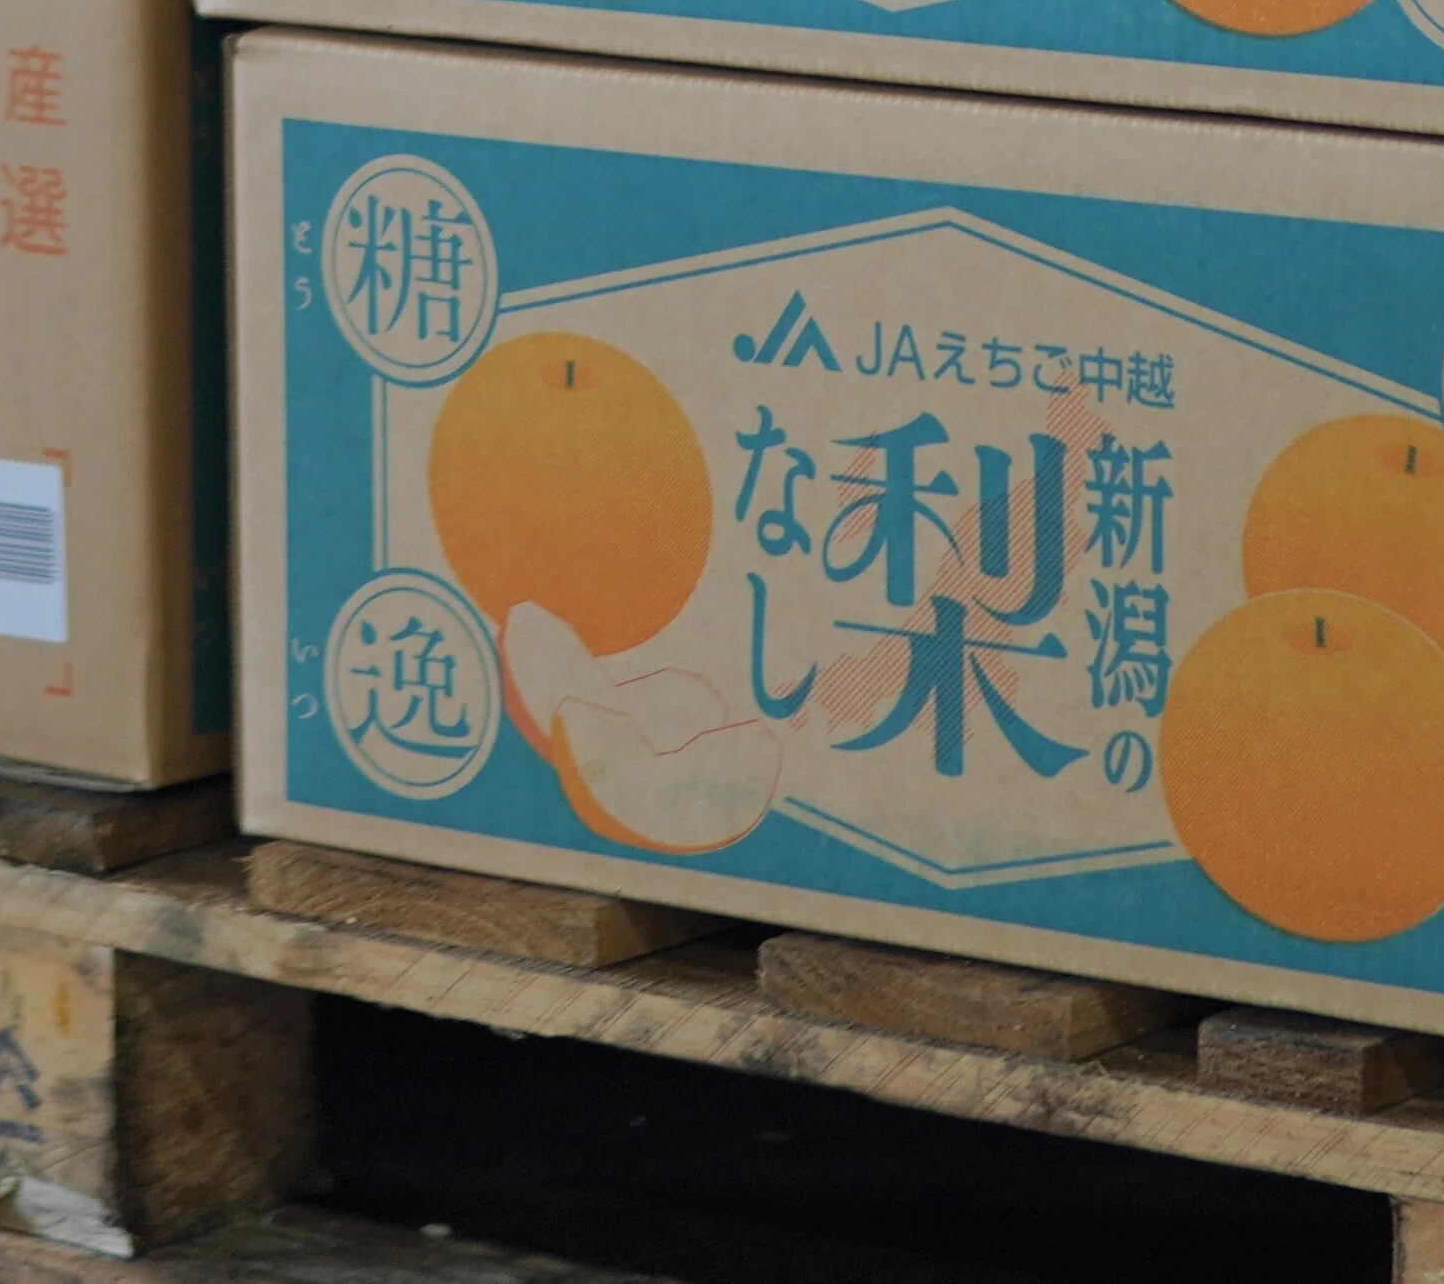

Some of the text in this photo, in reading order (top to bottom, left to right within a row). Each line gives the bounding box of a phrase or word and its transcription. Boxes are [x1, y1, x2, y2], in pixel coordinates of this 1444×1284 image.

[346, 194, 473, 344] 糖
[856, 321, 1176, 410] JAえちご中越
[735, 404, 817, 720] なし
[822, 412, 1089, 777] 梨
[1085, 434, 1174, 793] 新潟の
[350, 615, 480, 759] 逸
